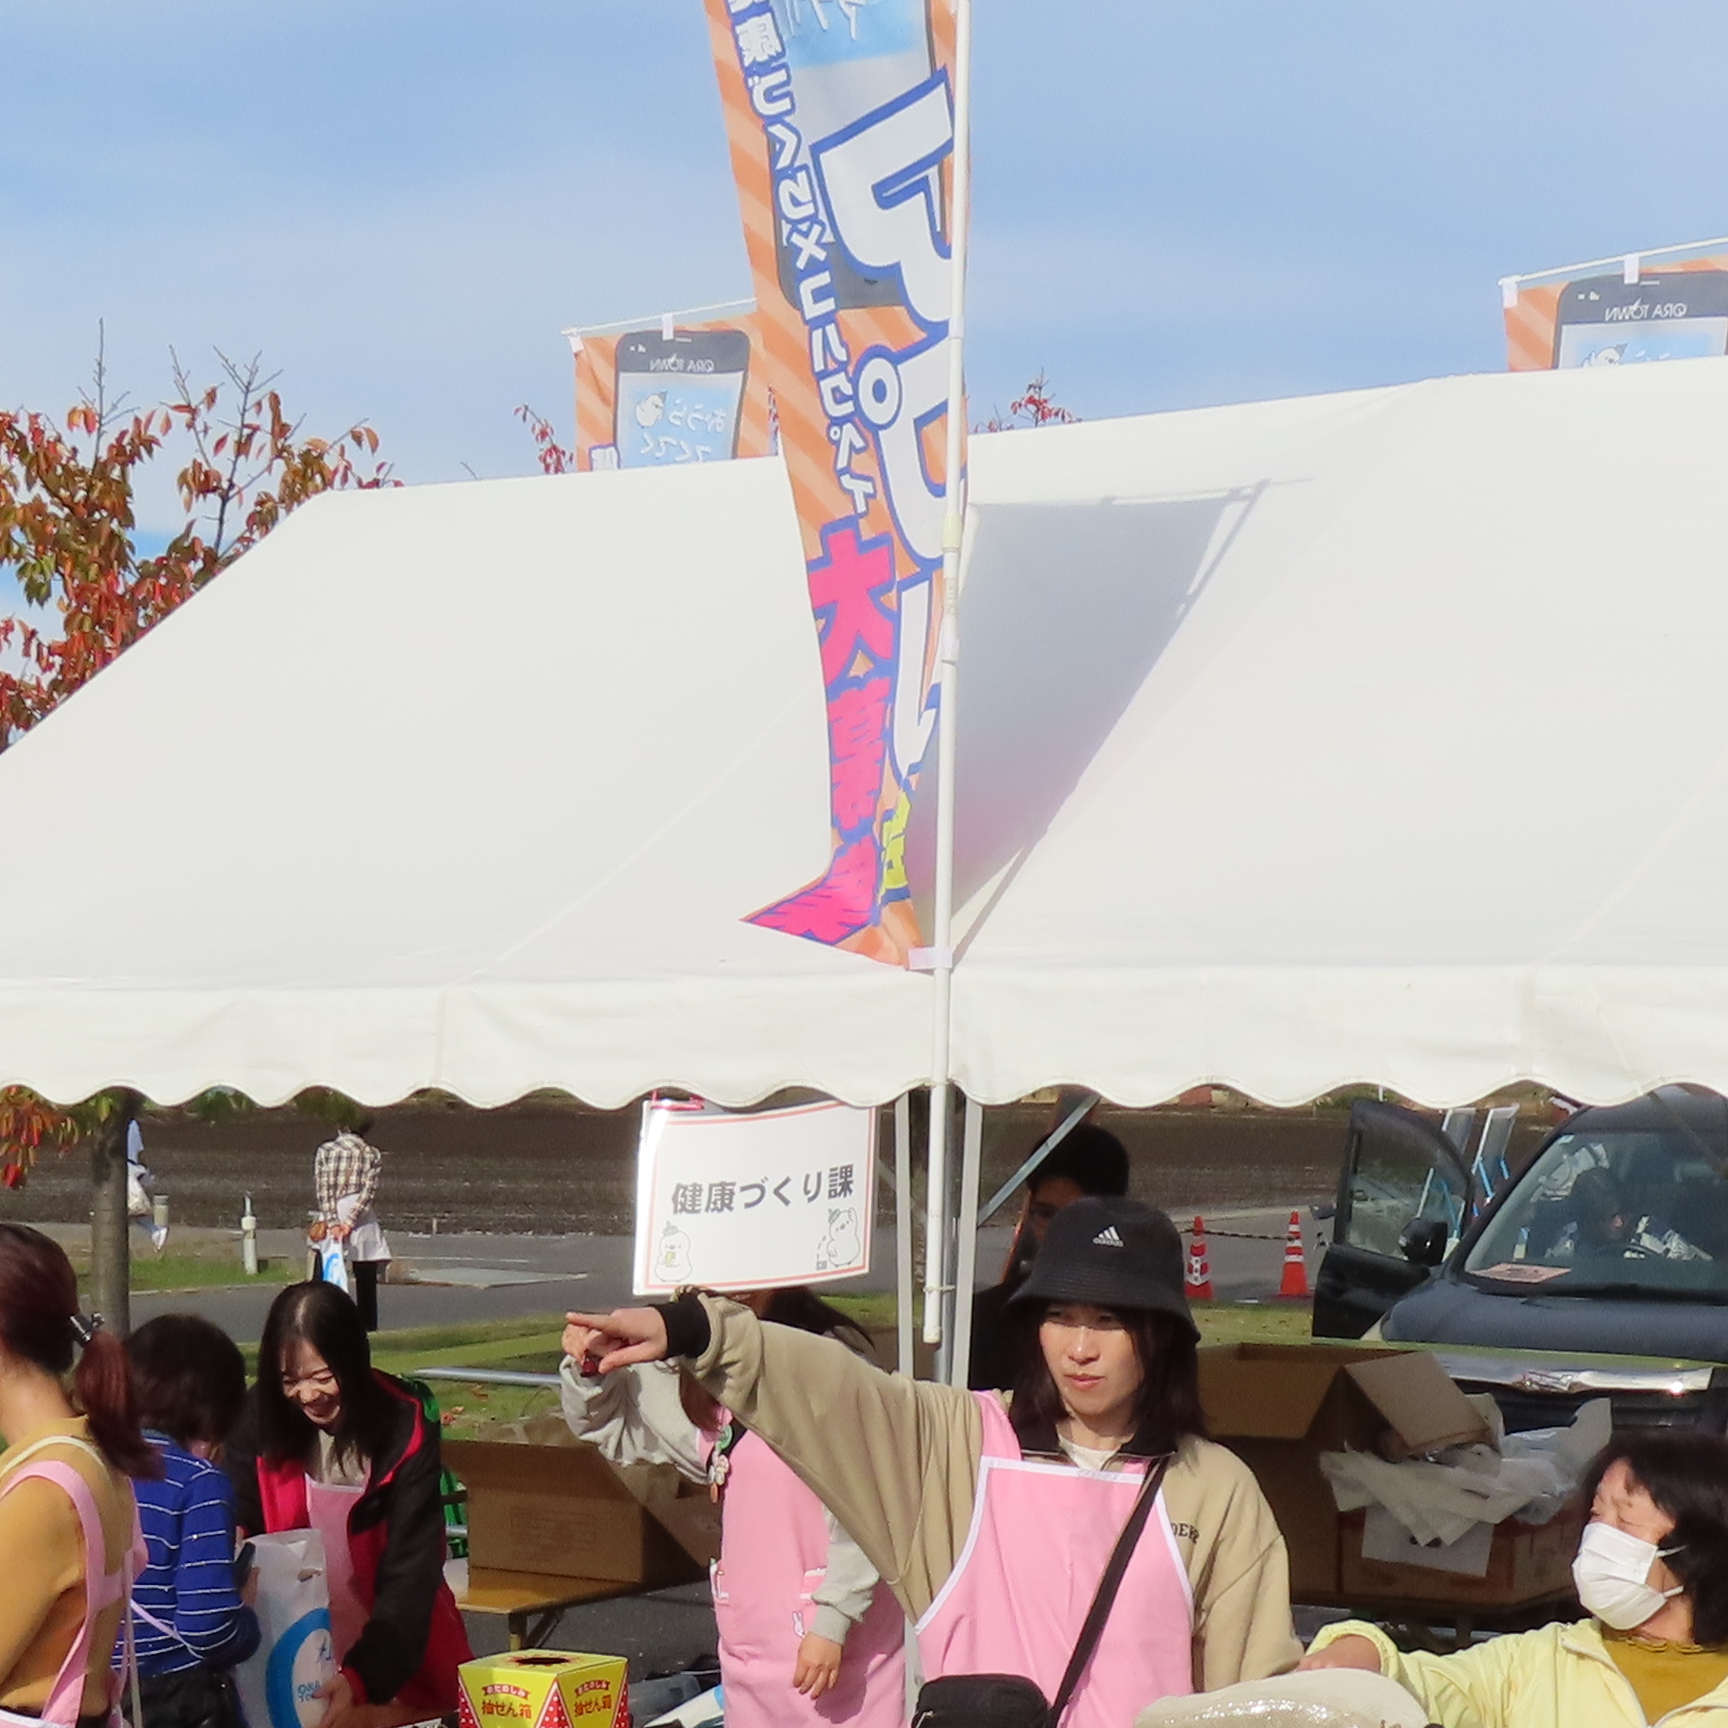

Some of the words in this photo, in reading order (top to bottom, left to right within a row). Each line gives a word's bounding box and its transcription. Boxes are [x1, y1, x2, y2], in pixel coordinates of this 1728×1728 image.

[672, 1164, 854, 1215] 健康づくり課
